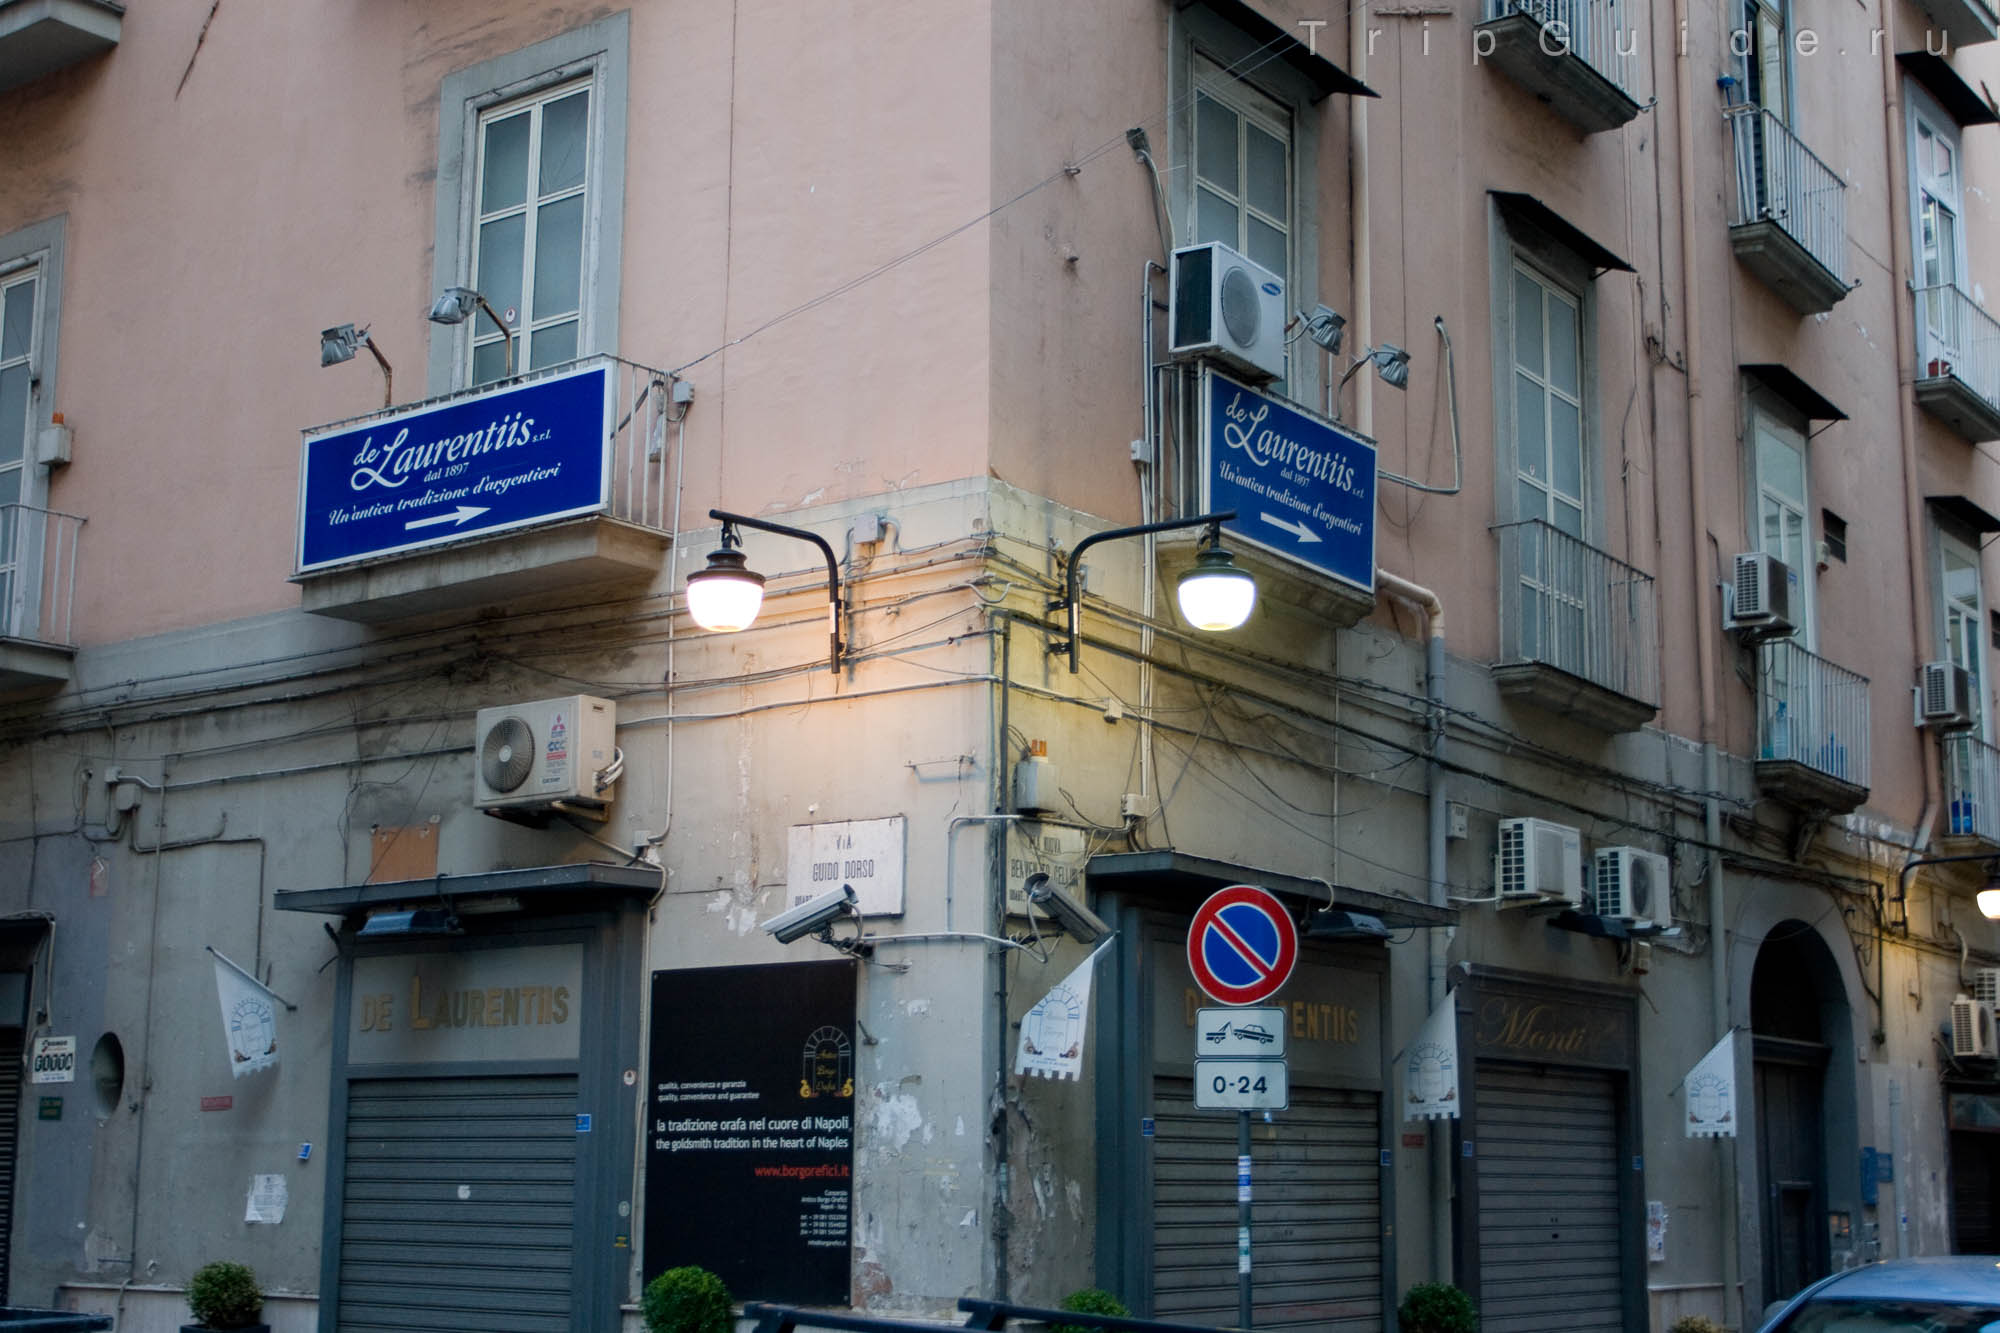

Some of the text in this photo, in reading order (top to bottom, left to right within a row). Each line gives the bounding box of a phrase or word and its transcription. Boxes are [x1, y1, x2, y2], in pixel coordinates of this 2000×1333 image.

[1225, 392, 1248, 423] de
[351, 411, 535, 491] Laurentiis
[353, 436, 380, 466] de
[1224, 404, 1355, 492] Laurentiis
[424, 462, 470, 483] dal 1897
[1280, 467, 1293, 481] dal
[397, 486, 469, 511] tradizione
[472, 462, 562, 495] d'argentieri
[1265, 484, 1312, 514] tradizione
[836, 834, 852, 850] VIA
[813, 859, 874, 882] GUIDO DORSO
[359, 975, 570, 1033] DE LAURENTIIS
[1213, 1075, 1268, 1094] 0-24
[656, 1116, 849, 1132] la tradizione orafa nel cuore di Napoli
[655, 1136, 849, 1151] the goldsmith tradition in the heart of Naples
